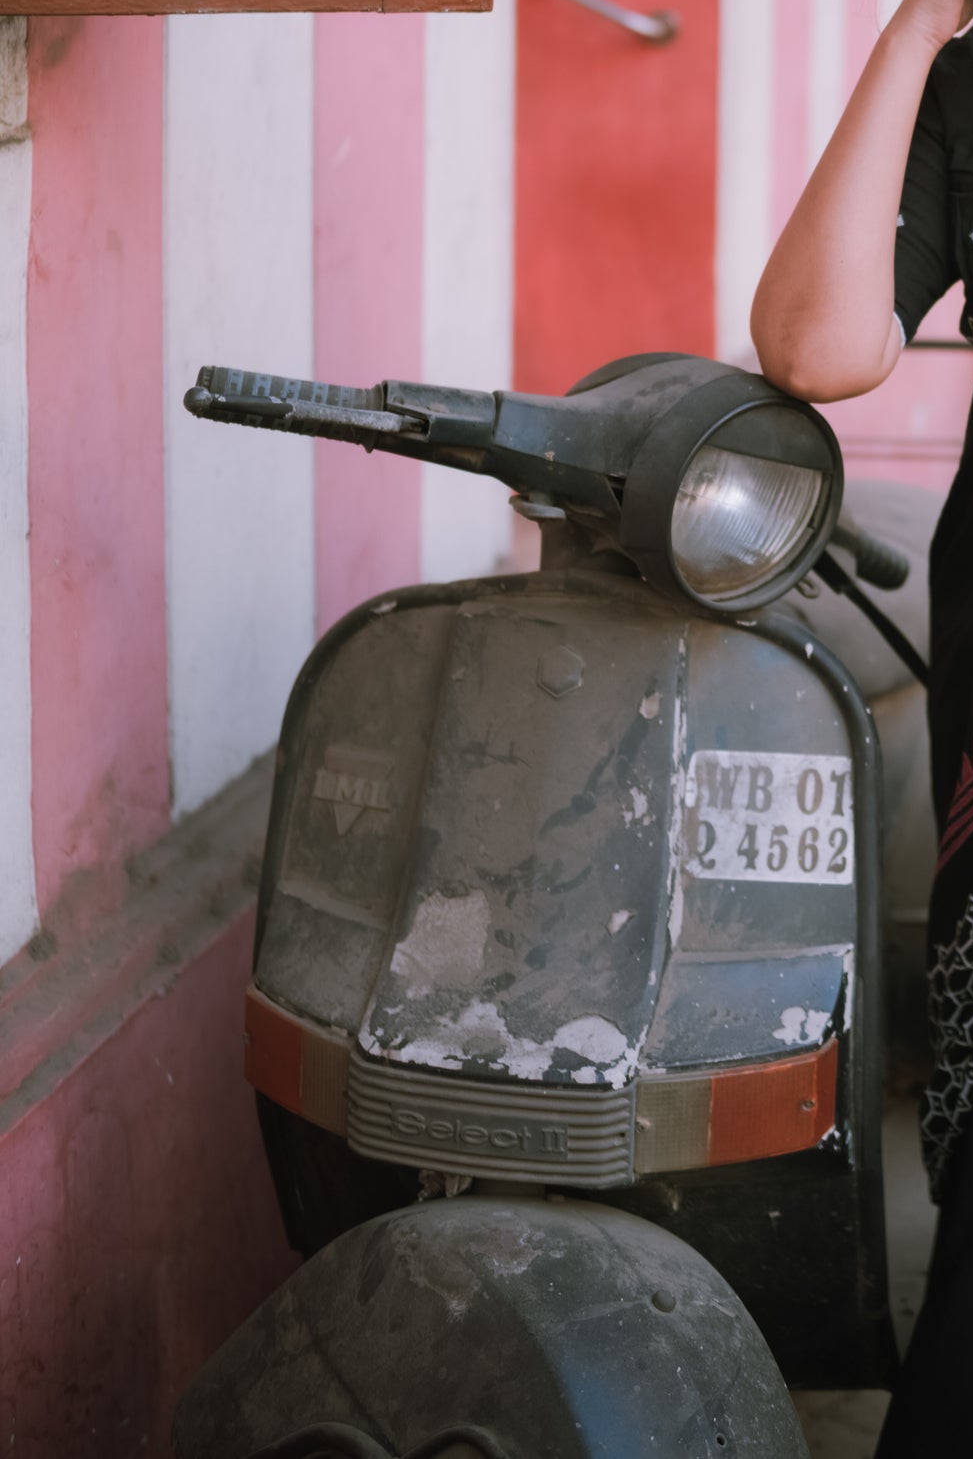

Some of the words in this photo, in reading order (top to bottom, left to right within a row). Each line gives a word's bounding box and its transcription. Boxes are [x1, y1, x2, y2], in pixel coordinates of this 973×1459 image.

[695, 762, 774, 813] WB
[796, 768, 851, 817] 01
[736, 823, 848, 874] 4562
[397, 1110, 532, 1150] Select
[541, 1127, 566, 1153] II
